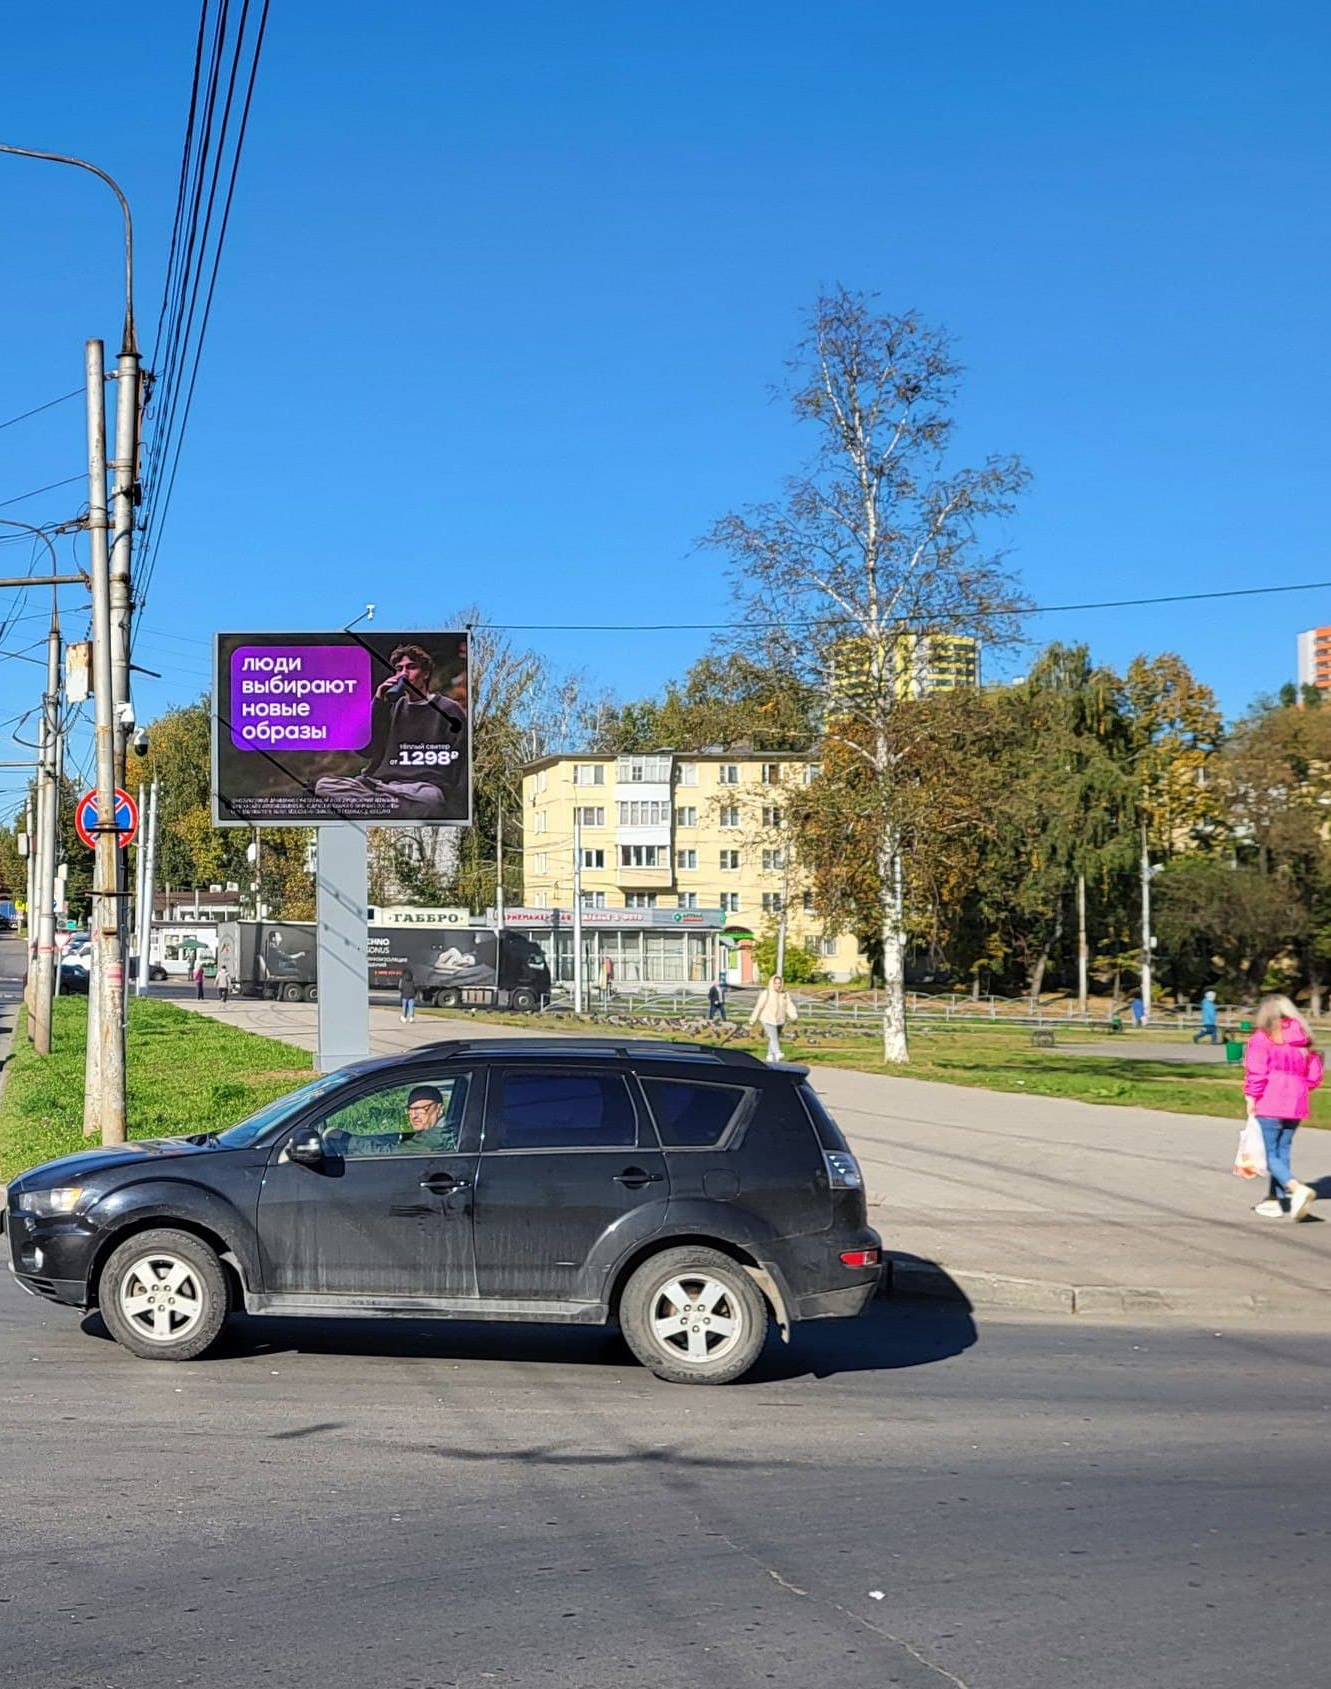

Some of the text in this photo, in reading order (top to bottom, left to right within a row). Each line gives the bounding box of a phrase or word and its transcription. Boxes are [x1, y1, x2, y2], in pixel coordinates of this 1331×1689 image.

[241, 656, 302, 674] люди
[241, 675, 358, 698] выбирают
[241, 701, 311, 717] новые
[241, 721, 327, 743] образы
[393, 913, 459, 923] ГАББРО
[368, 938, 390, 946] CHNO
